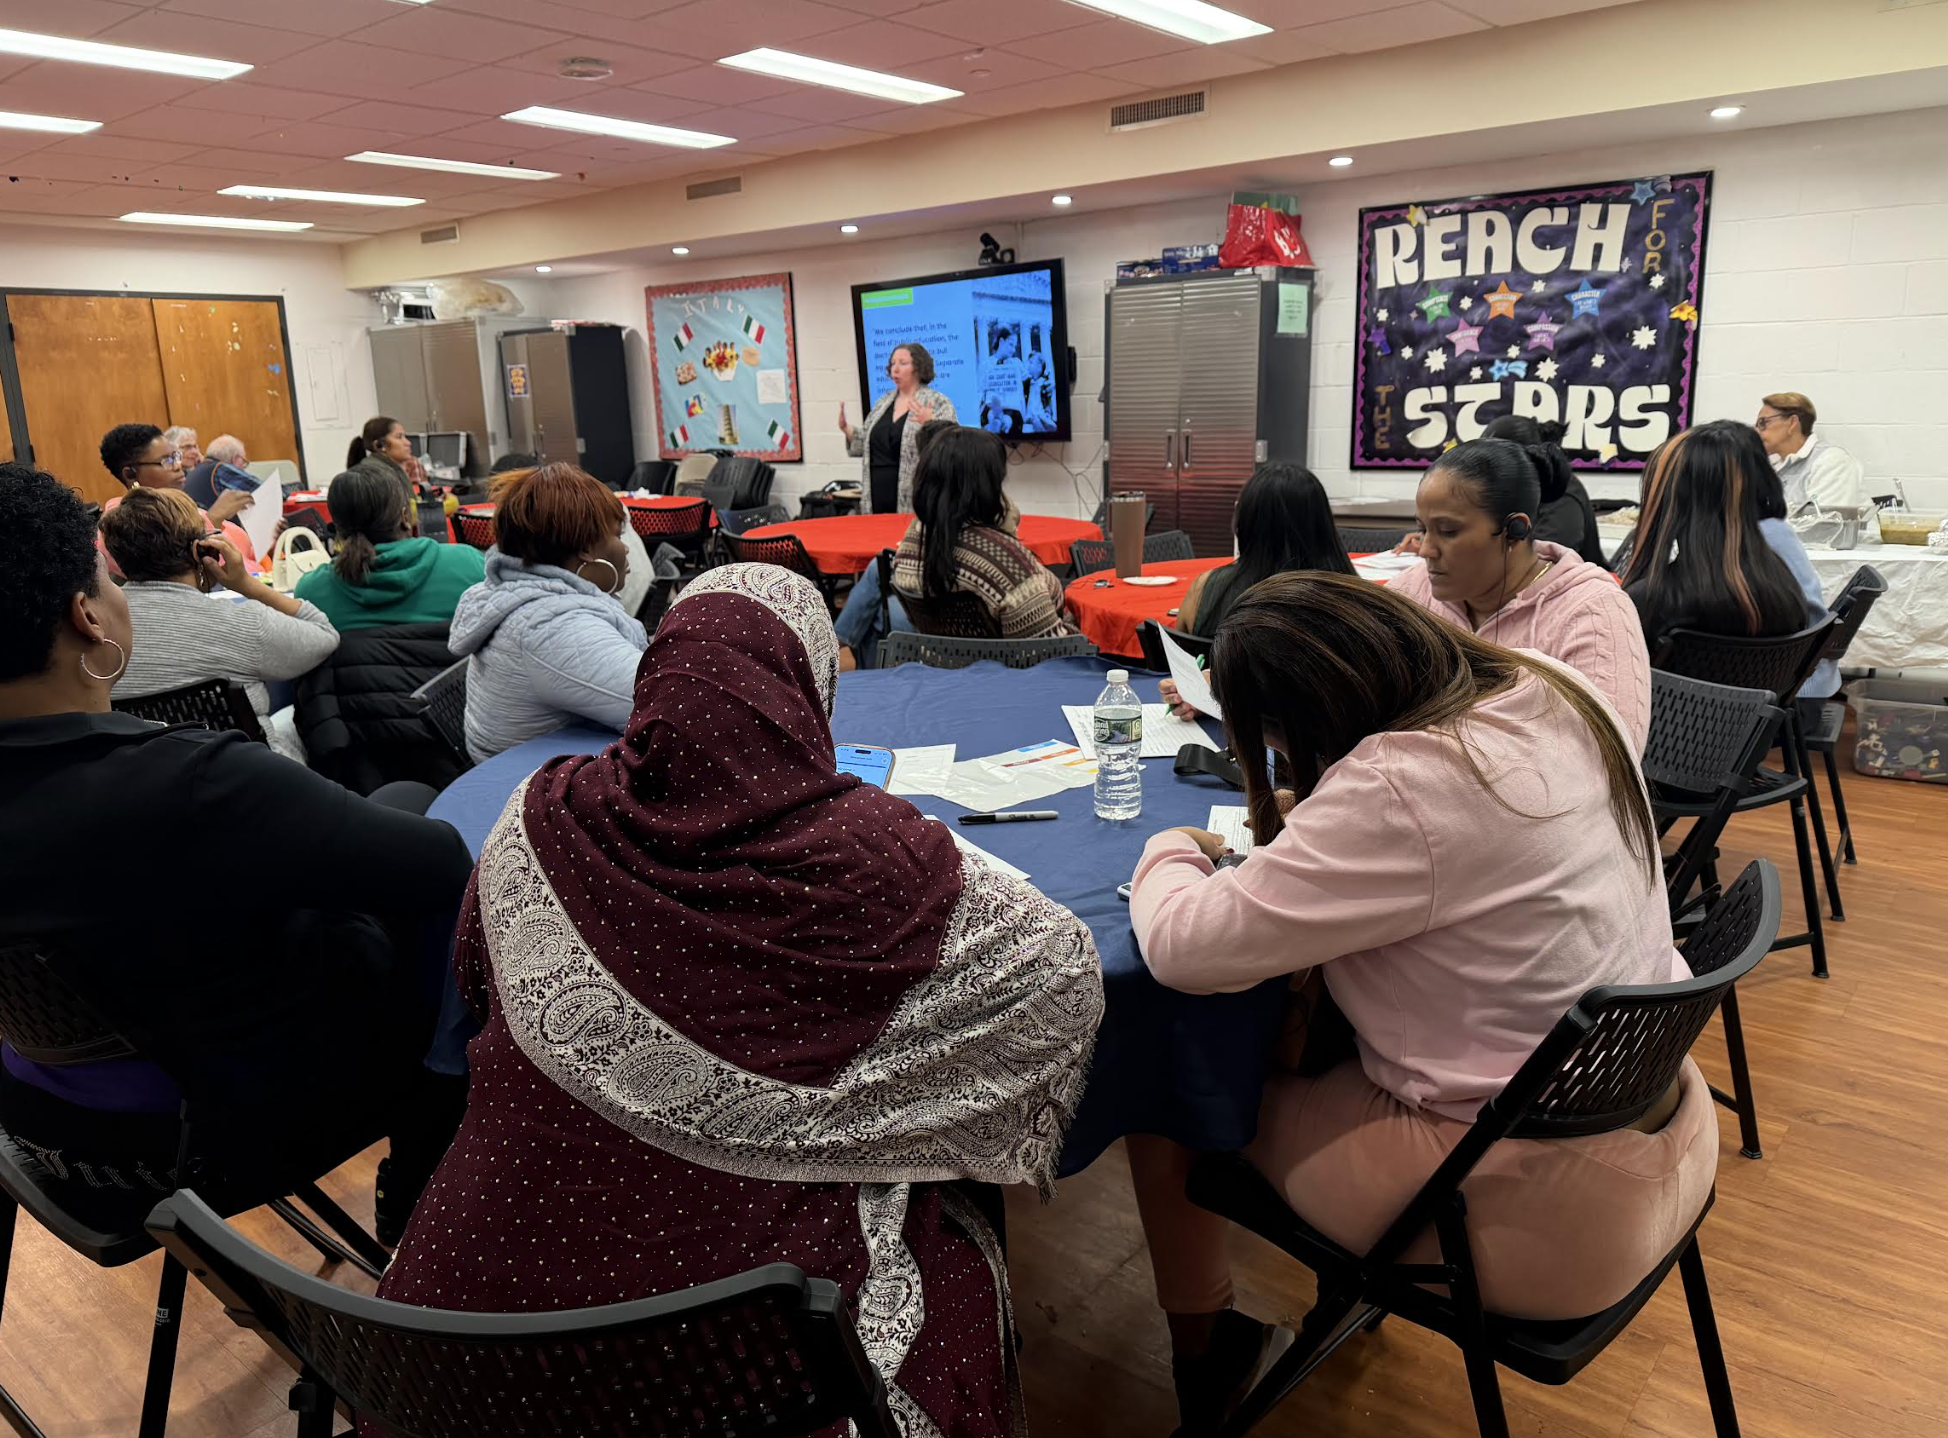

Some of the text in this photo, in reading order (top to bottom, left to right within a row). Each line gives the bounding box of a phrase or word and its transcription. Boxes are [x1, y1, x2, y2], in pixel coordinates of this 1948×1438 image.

[1374, 203, 1631, 289] REACH
[1642, 199, 1675, 273] FOR
[681, 296, 745, 318] ITALY
[1373, 385, 1394, 449] THE
[1404, 381, 1671, 452] STARS
